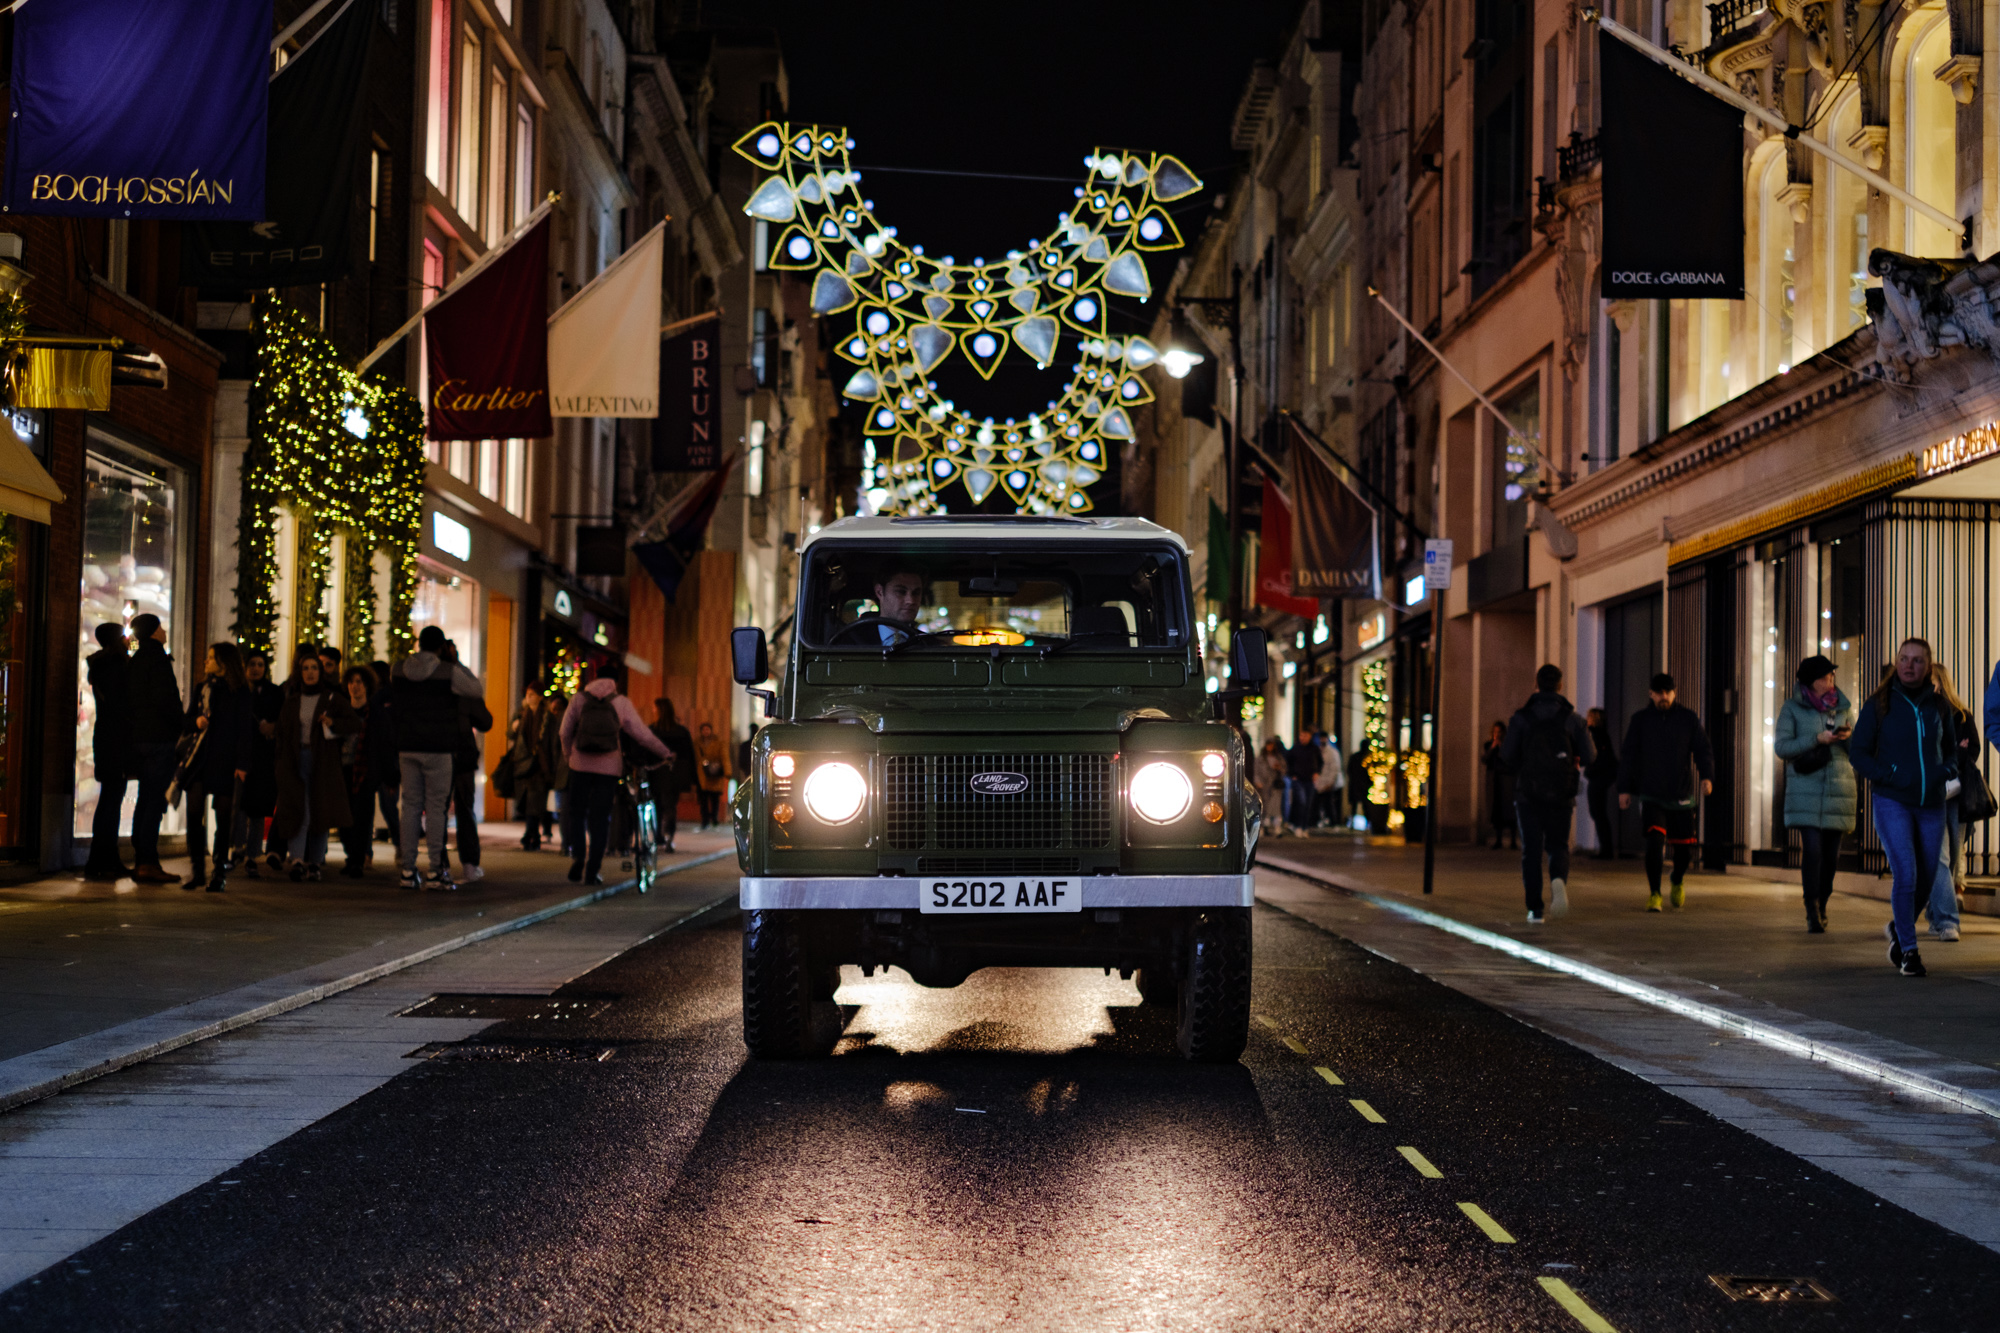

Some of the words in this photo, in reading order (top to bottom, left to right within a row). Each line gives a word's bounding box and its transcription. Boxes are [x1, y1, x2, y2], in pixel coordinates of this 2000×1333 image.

[1612, 271, 1652, 284] DOLCE
[1660, 271, 1726, 285] GABBANA
[433, 379, 543, 412] Cartier
[691, 340, 709, 442] BRUN
[553, 395, 652, 414] VALENTINO
[687, 446, 712, 456] FINE
[690, 457, 711, 466] ART
[978, 775, 1002, 783] LAND
[992, 783, 1021, 791] ROVER
[932, 882, 1005, 907] S202
[1015, 881, 1068, 906] AAF
